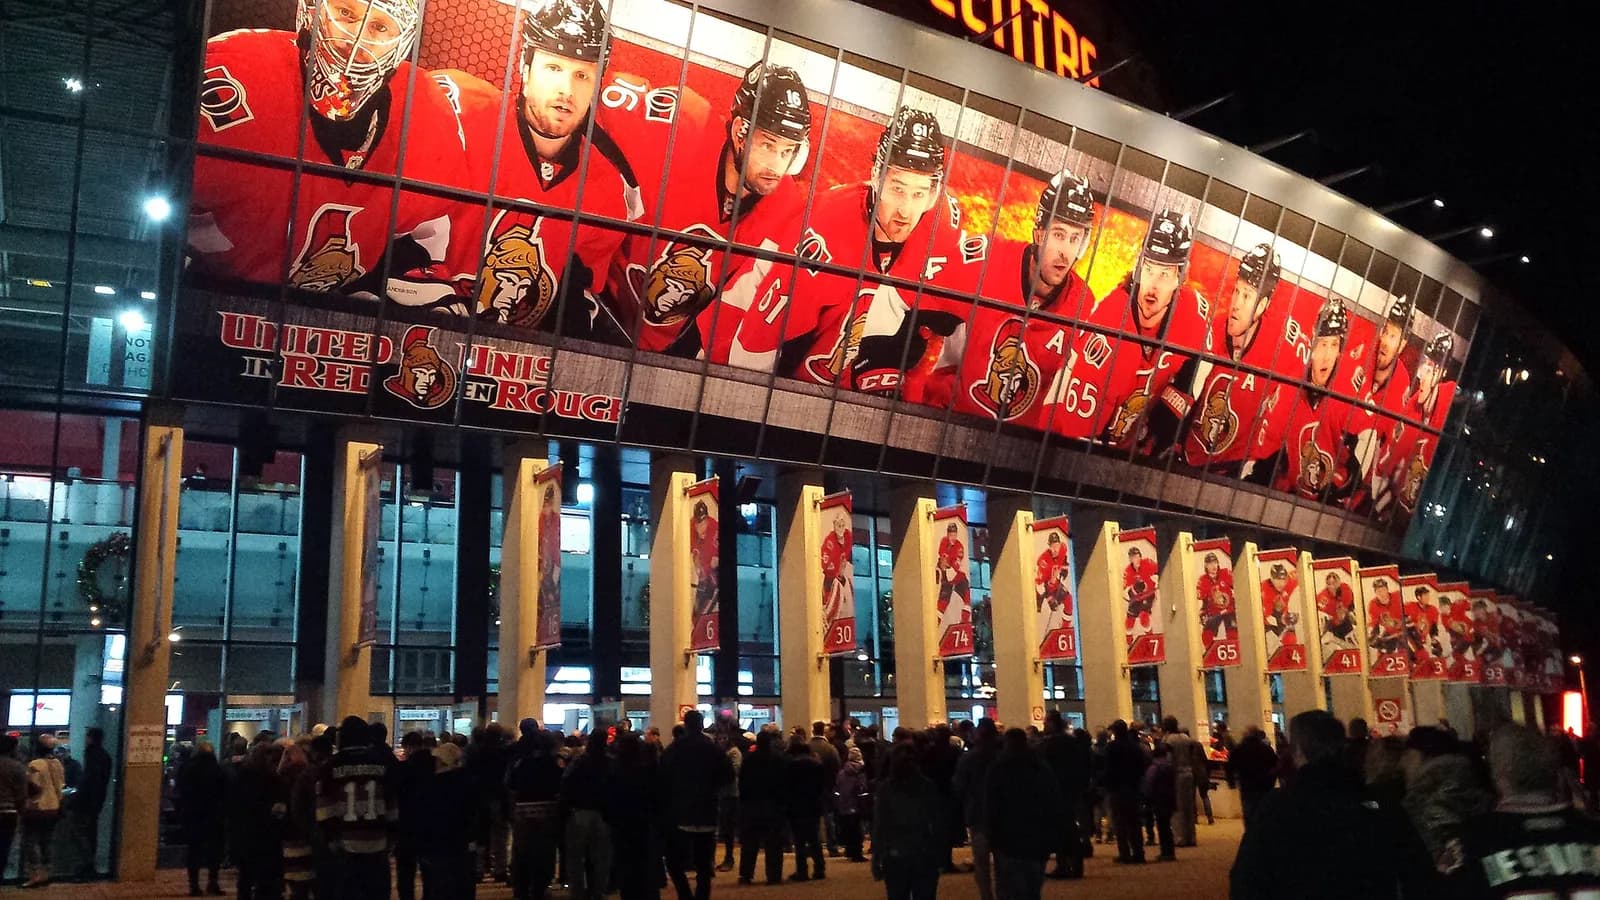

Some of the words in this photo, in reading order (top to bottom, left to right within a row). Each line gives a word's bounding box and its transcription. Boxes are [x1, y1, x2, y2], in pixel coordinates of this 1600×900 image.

[930, 0, 1100, 88] NTRE
[785, 89, 801, 107] 16
[912, 124, 928, 138] 61
[758, 278, 789, 325] 61
[217, 311, 393, 364] UNITED
[1045, 329, 1066, 354] A
[456, 343, 553, 384] UNIS
[861, 373, 905, 390] CC
[1241, 373, 1255, 391] A
[488, 379, 629, 424] ROUGE
[1065, 377, 1098, 418] 65
[706, 620, 714, 641] 6
[836, 626, 852, 645] 30
[951, 630, 969, 648] 74
[1057, 635, 1073, 651] 61
[1149, 639, 1158, 656] 7
[1216, 644, 1237, 660] 65
[1291, 649, 1301, 664] 4
[1340, 653, 1357, 668] 41
[1385, 656, 1406, 672] 25
[1434, 661, 1443, 675] 3
[1464, 663, 1473, 677] 5
[344, 780, 377, 821] 11
